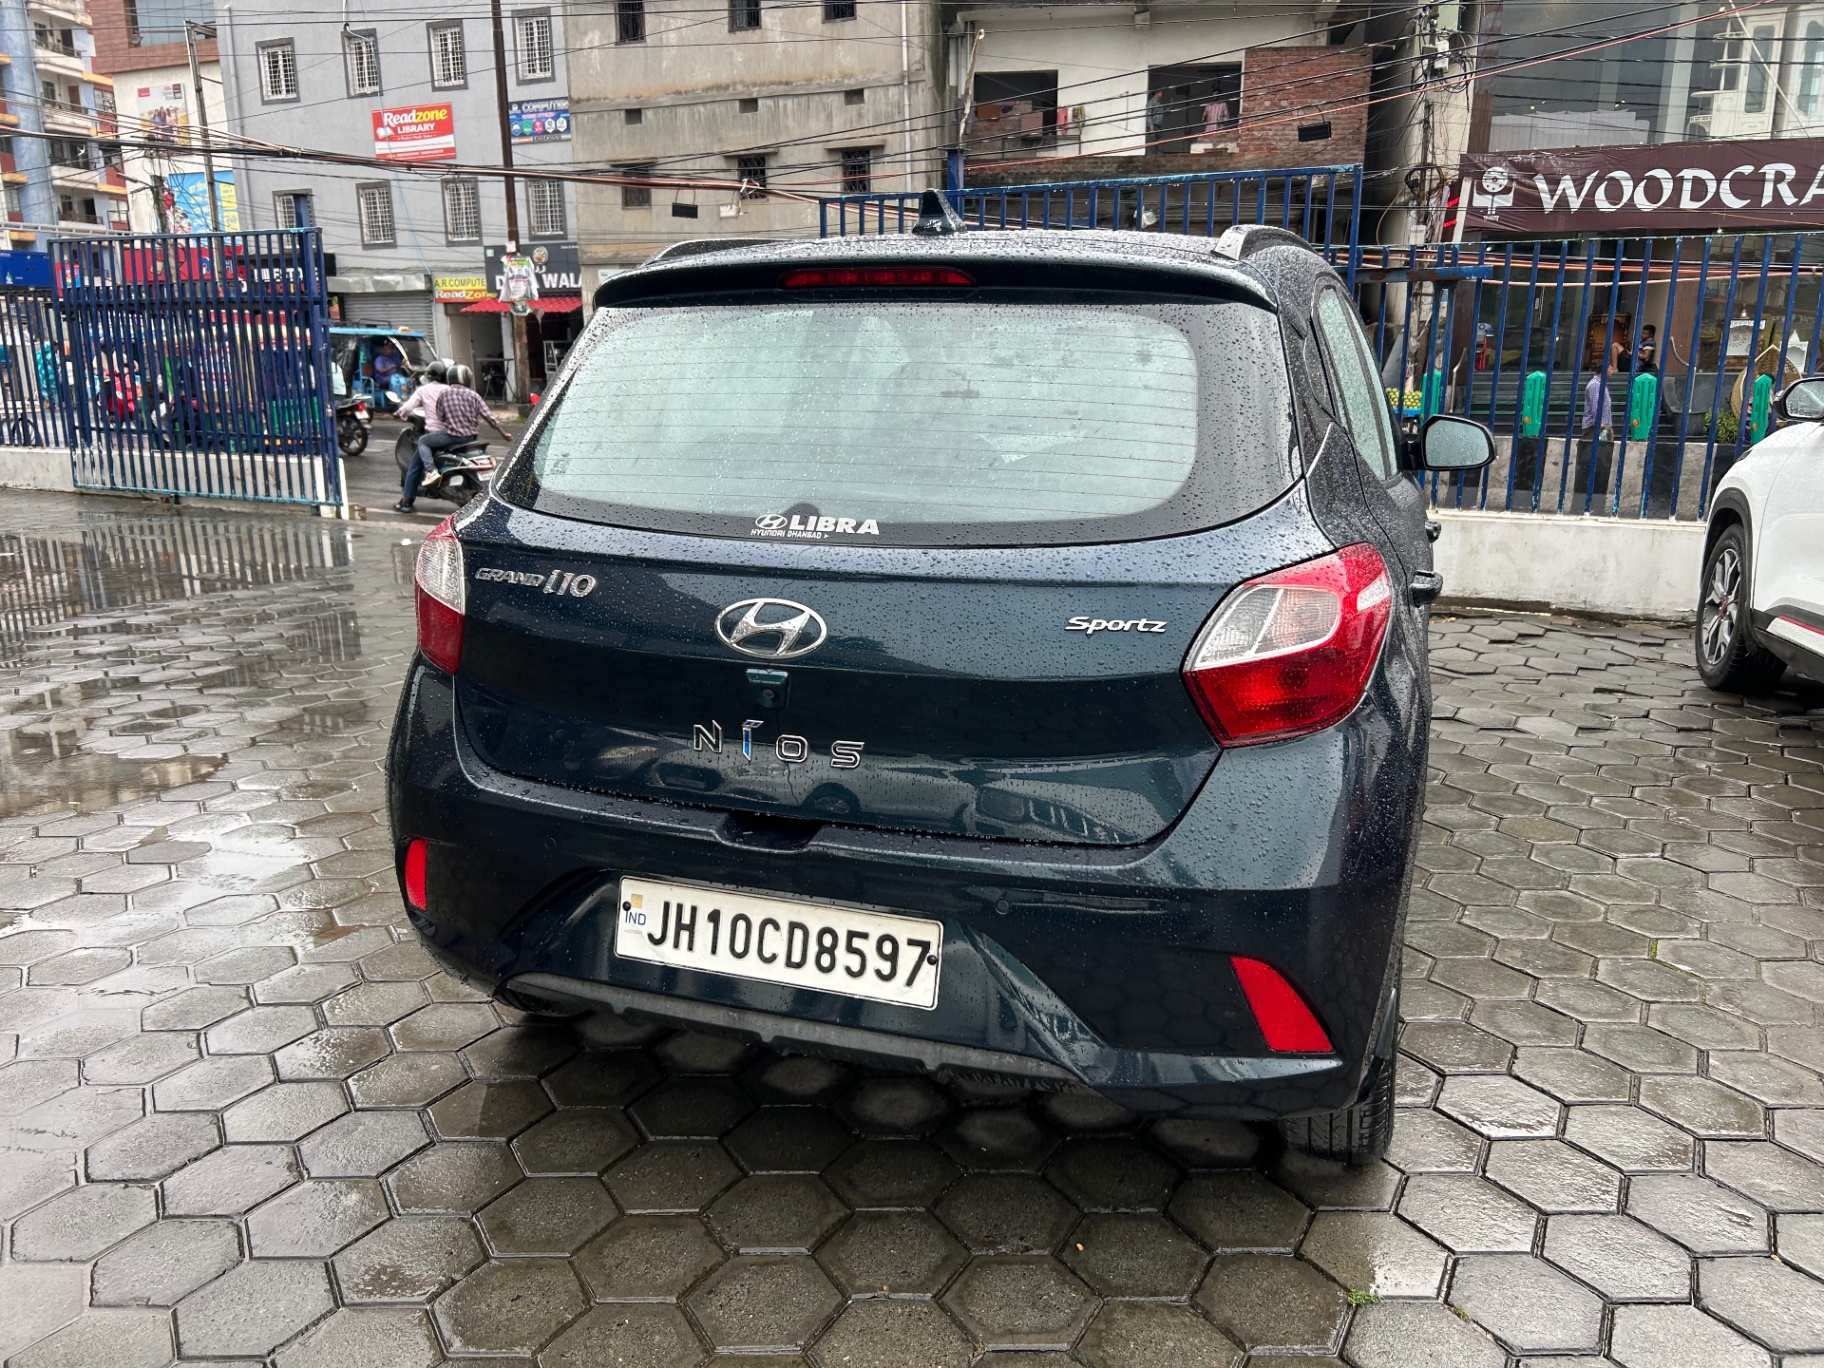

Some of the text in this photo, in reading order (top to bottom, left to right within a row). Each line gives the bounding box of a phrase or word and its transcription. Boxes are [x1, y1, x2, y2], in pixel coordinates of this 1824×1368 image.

[383, 108, 448, 127] Readzone
[397, 122, 435, 134] LIBRARY
[787, 530, 822, 539] DHANBAD
[788, 514, 880, 536] LIBRA
[474, 567, 545, 587] GRAND
[1064, 616, 1168, 635] Sportz
[625, 911, 646, 926] IND
[647, 900, 932, 987] JH10CD8597
